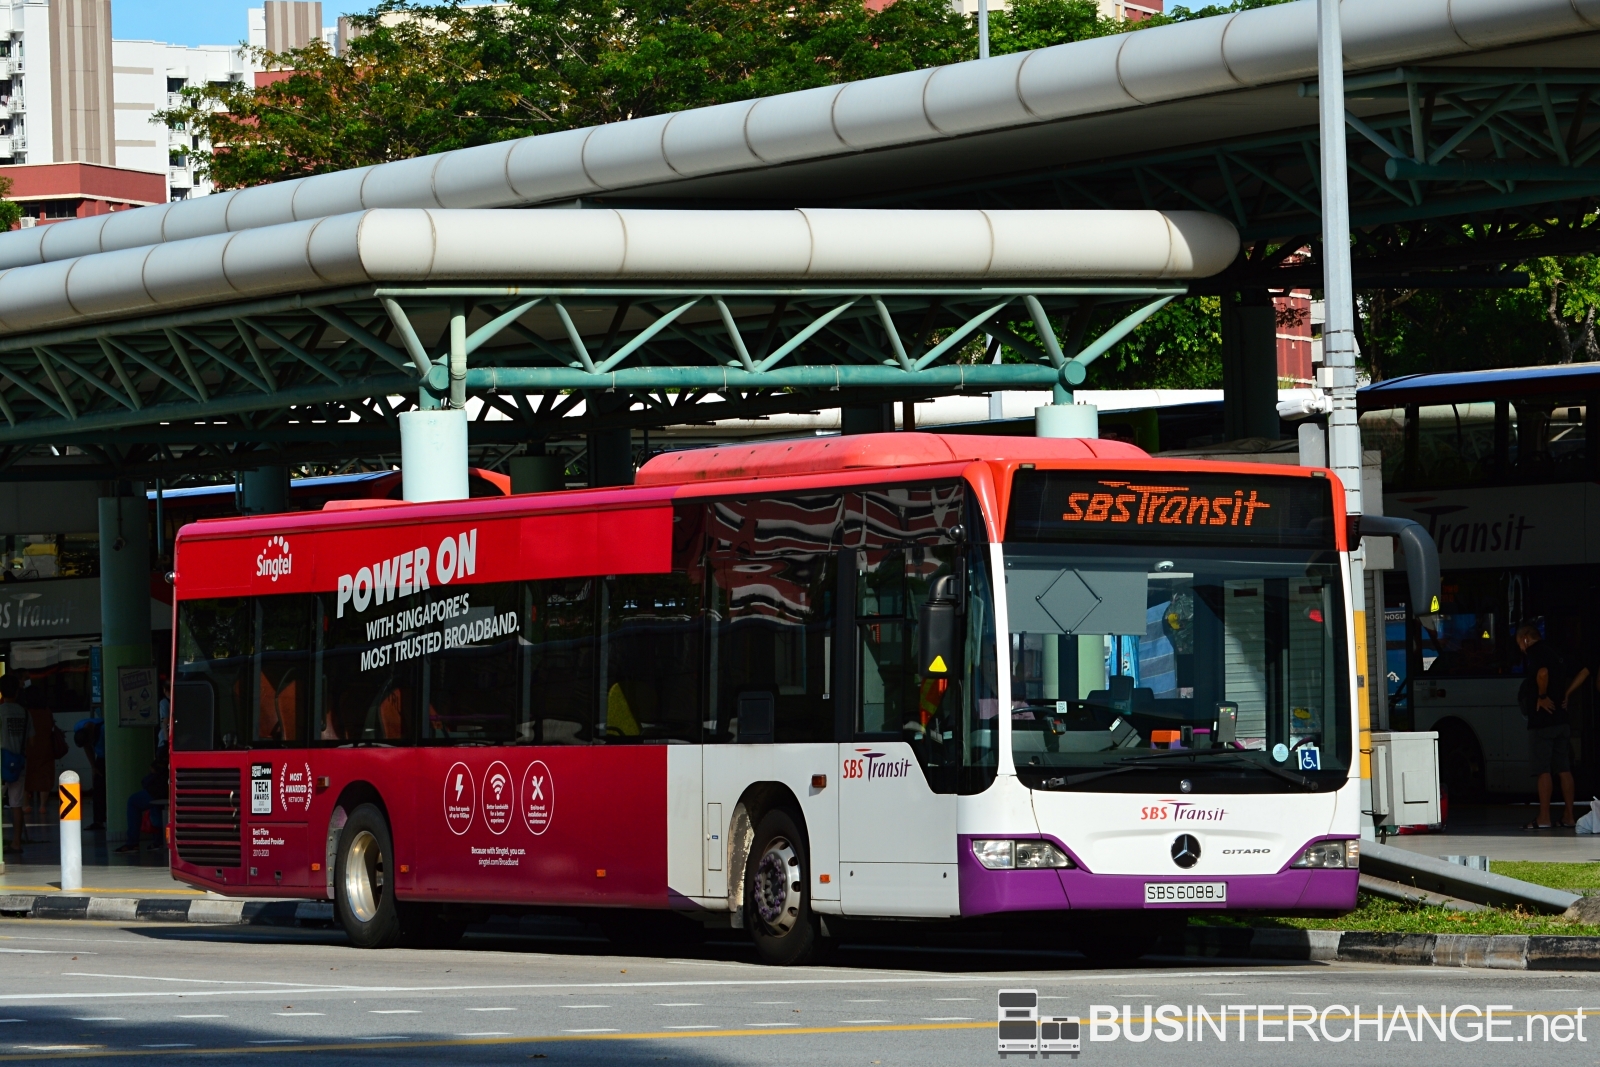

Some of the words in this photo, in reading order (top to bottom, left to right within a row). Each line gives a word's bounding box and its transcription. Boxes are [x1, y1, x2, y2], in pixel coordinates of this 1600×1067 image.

[1413, 505, 1535, 554] Transit
[256, 553, 292, 582] Singtel
[336, 546, 430, 618] POWER
[436, 528, 477, 584] ON
[366, 614, 394, 641] WITH
[396, 593, 469, 633] SINGAPORE'S
[360, 644, 392, 671] MOST
[394, 631, 442, 662] TRUSTED
[444, 611, 520, 650] BROADBAND.
[289, 773, 303, 781] MOST
[843, 759, 863, 779] SBS
[862, 753, 912, 782] Transit
[255, 782, 268, 792] TECH
[285, 785, 307, 793] AWARDED
[1141, 806, 1168, 820] SBS
[1167, 802, 1229, 822] Transit
[271, 838, 285, 846] Provider
[495, 847, 509, 856] Singtel,
